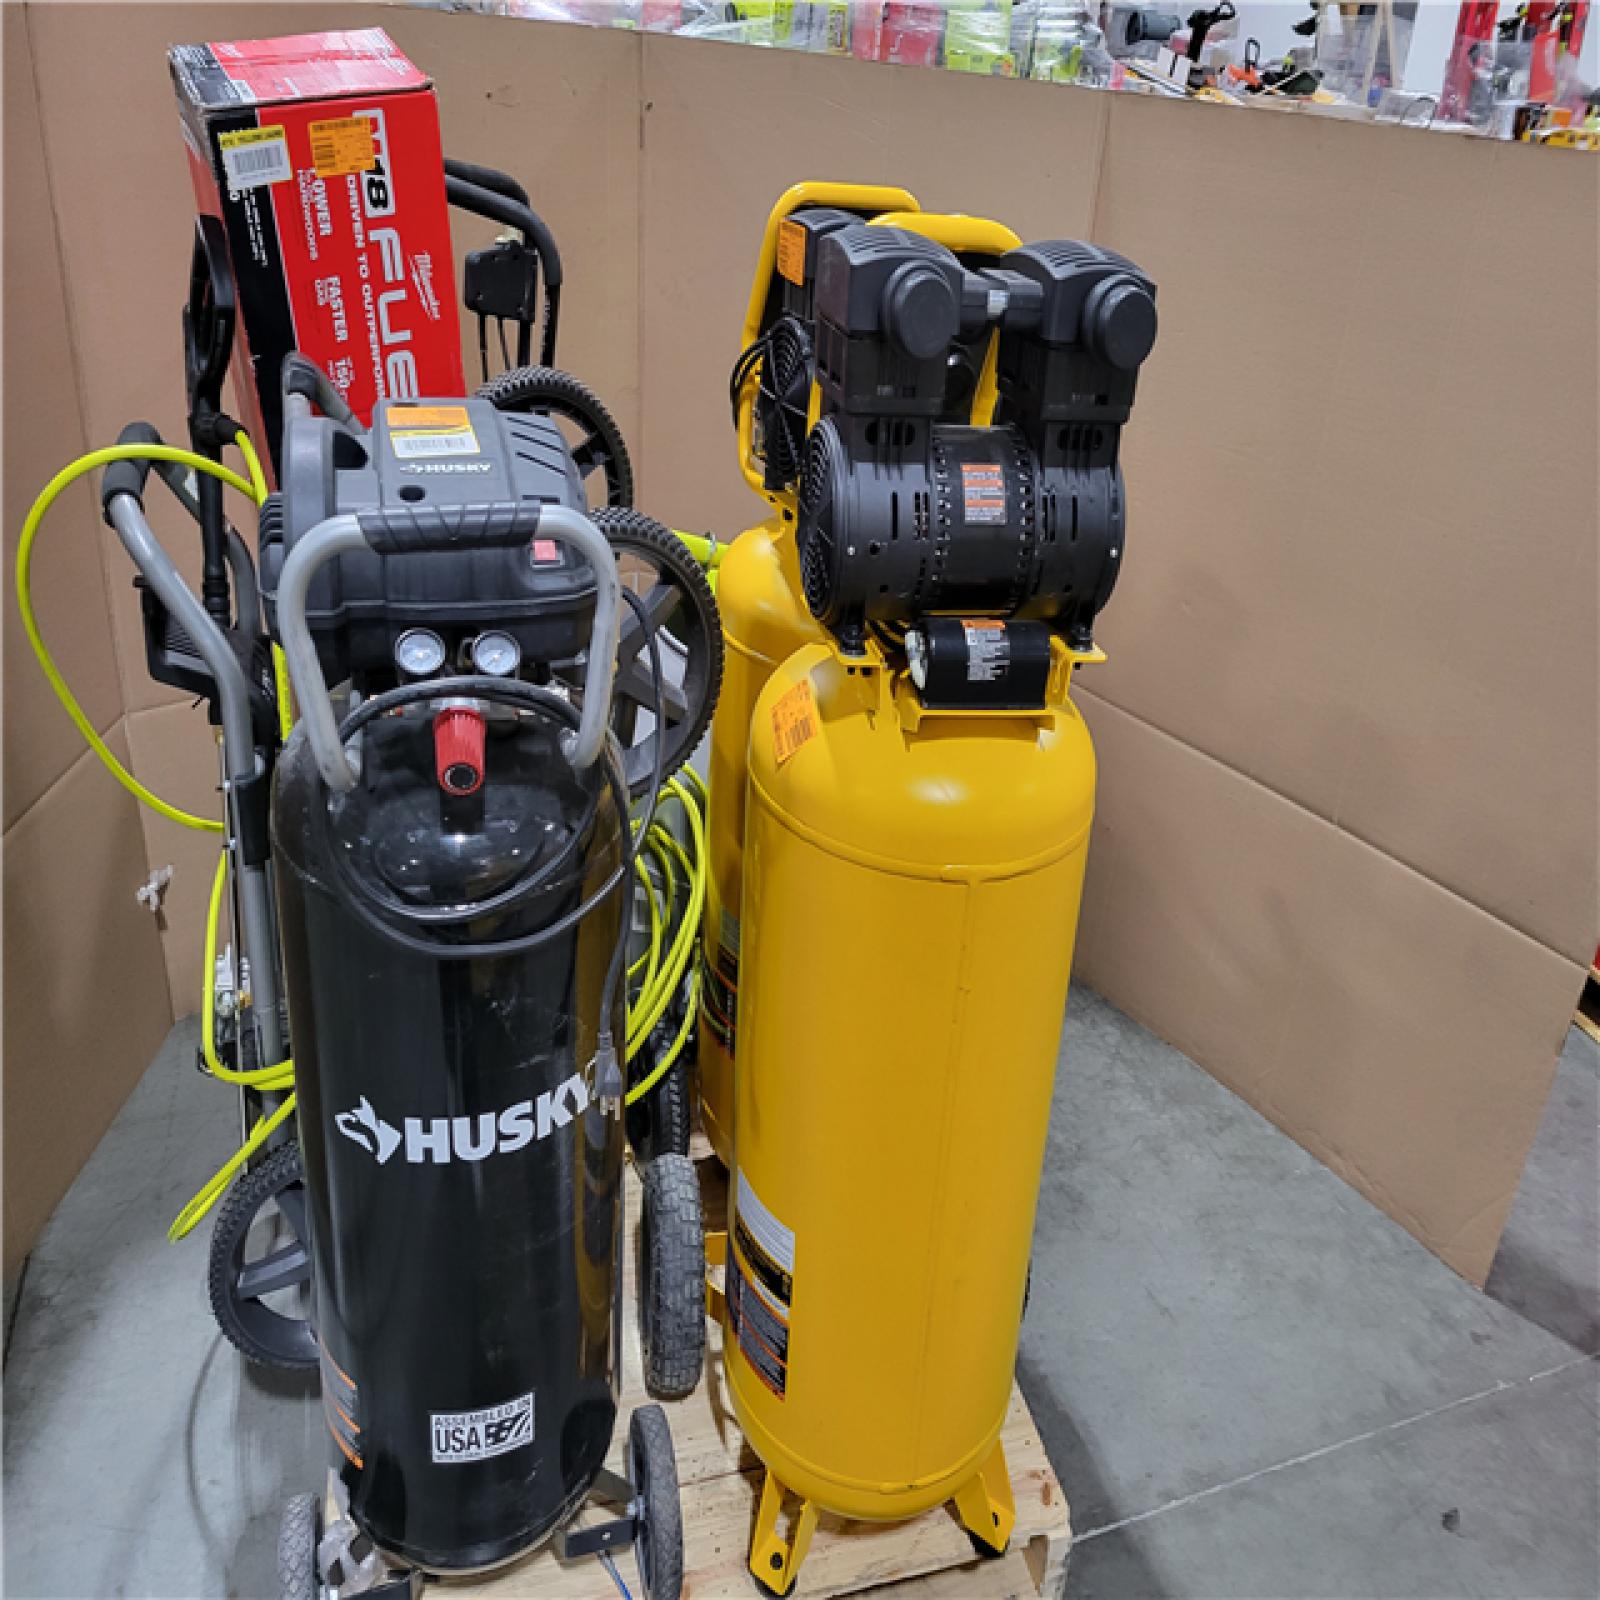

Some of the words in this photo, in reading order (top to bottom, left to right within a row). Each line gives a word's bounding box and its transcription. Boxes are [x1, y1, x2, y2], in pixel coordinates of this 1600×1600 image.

[312, 172, 333, 236] OWER
[346, 174, 366, 248] DRIVEN
[357, 252, 369, 278] TO
[327, 275, 348, 342] FASTER
[369, 228, 419, 399] FUE
[424, 462, 491, 474] HUSKY
[435, 1426, 480, 1453] USA
